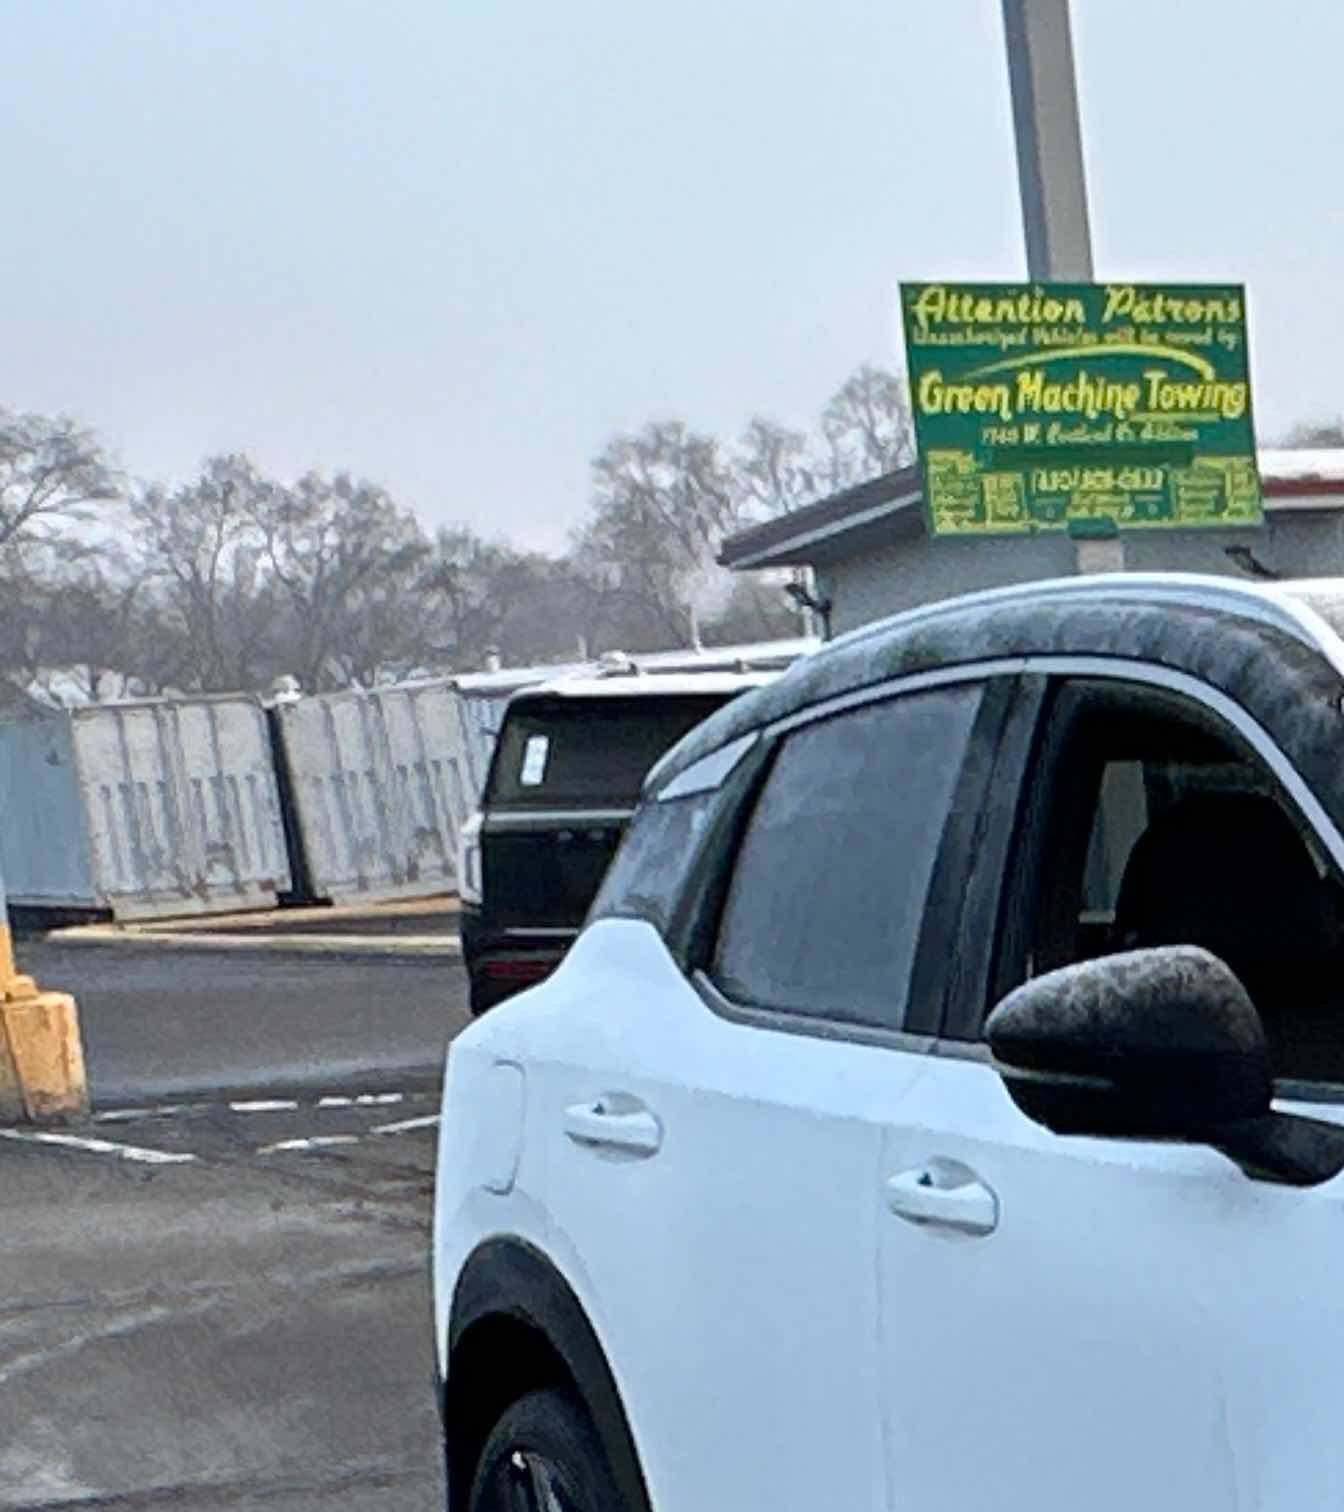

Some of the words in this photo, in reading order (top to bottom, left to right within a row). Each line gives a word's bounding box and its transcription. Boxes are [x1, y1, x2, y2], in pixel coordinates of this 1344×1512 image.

[912, 286, 1085, 323] Attention
[1102, 286, 1242, 322] Patrons
[919, 369, 1013, 421] Green
[1016, 370, 1141, 420] Machine
[1143, 371, 1247, 420] Towing
